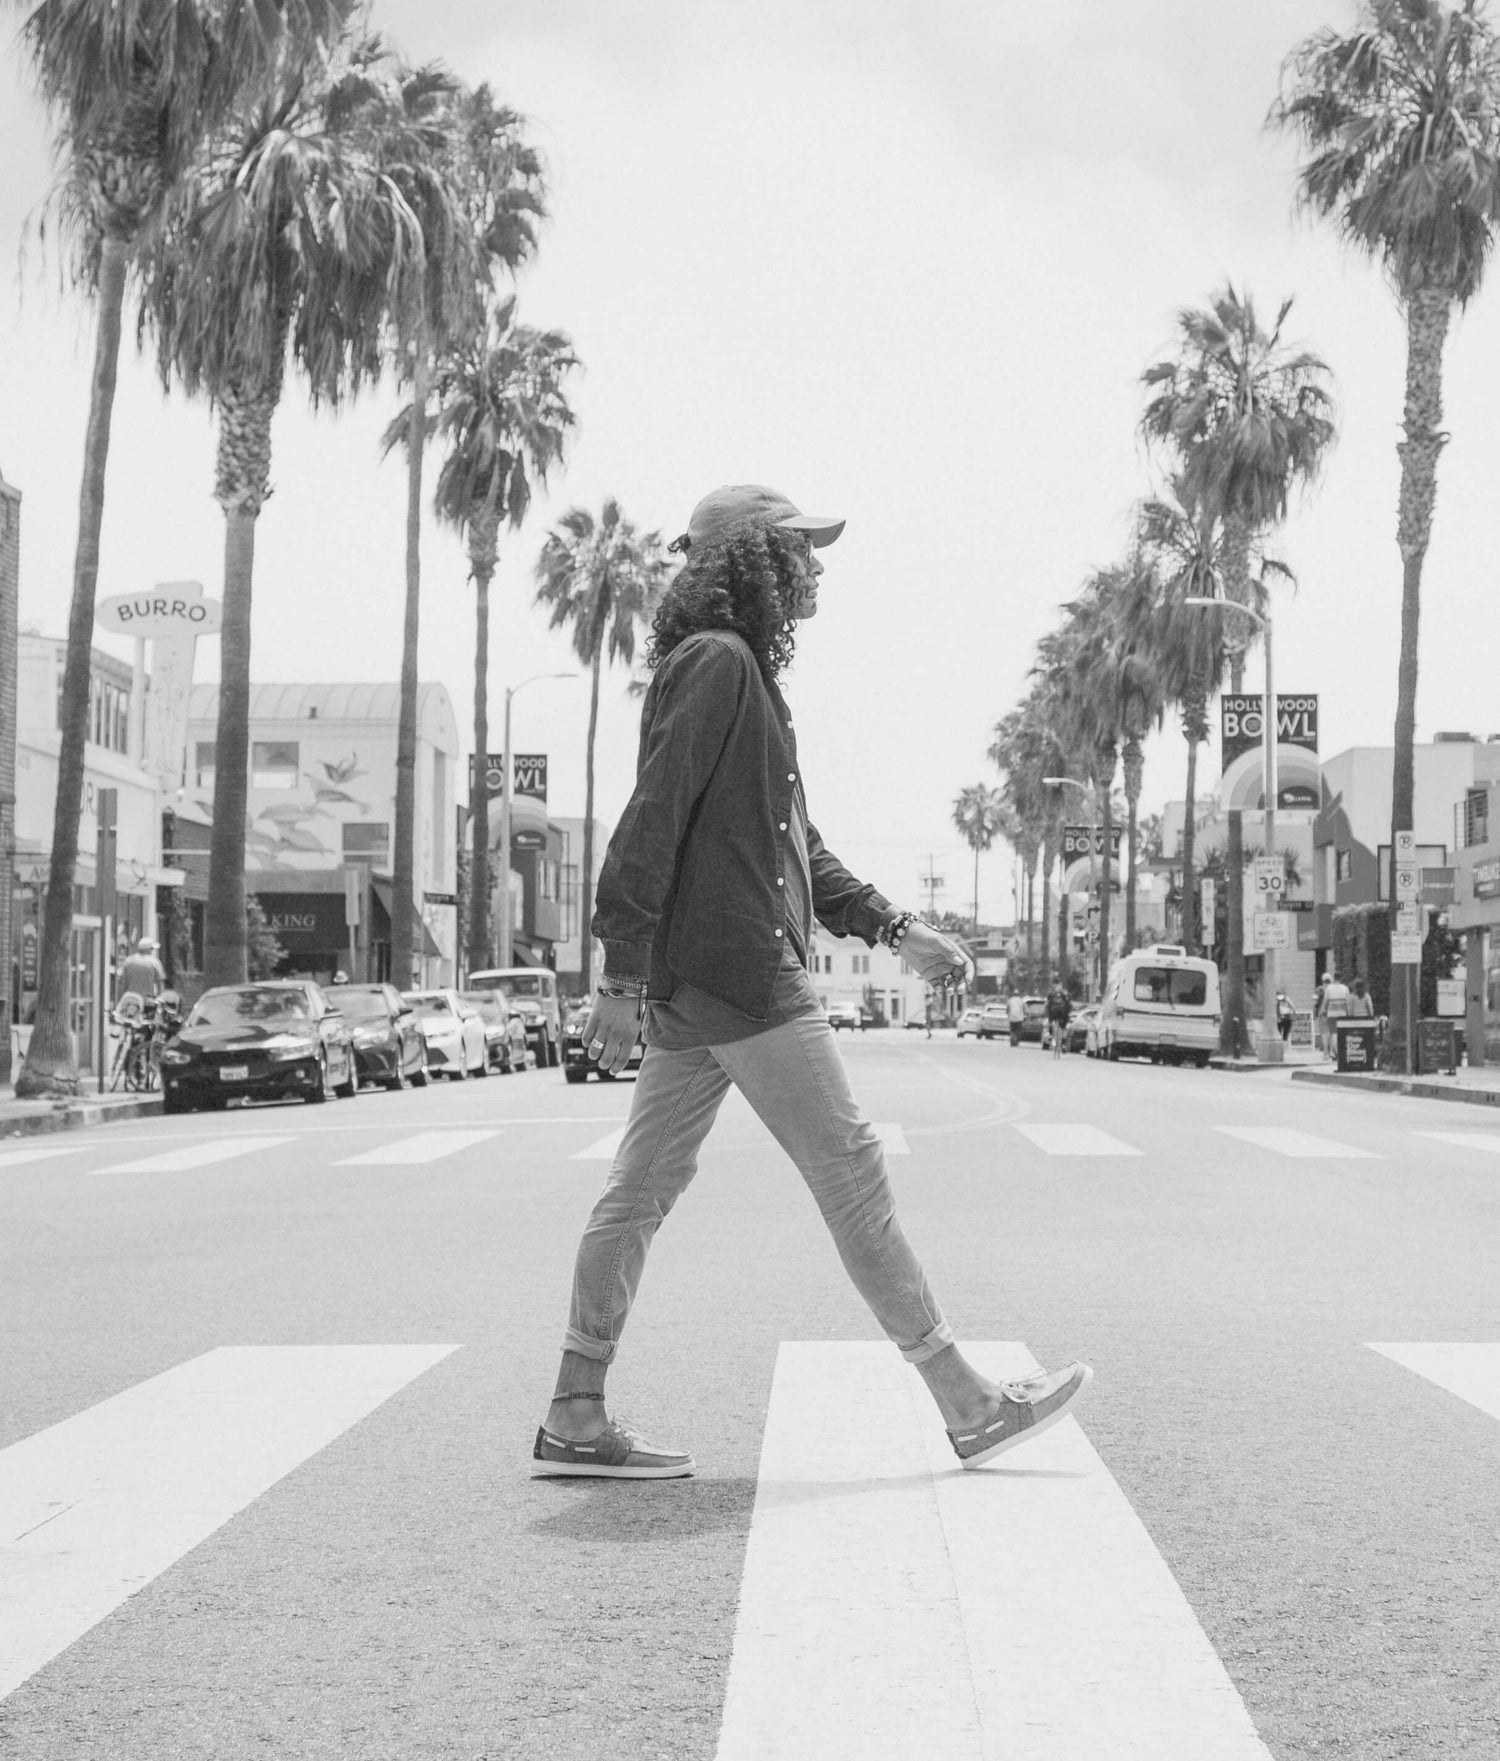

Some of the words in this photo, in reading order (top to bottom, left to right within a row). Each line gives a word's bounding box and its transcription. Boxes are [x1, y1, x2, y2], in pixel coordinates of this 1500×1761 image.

[117, 599, 207, 622] BURRO
[1223, 712, 1317, 737] BOWL
[1259, 876, 1282, 890] 30
[271, 913, 316, 927] KING
